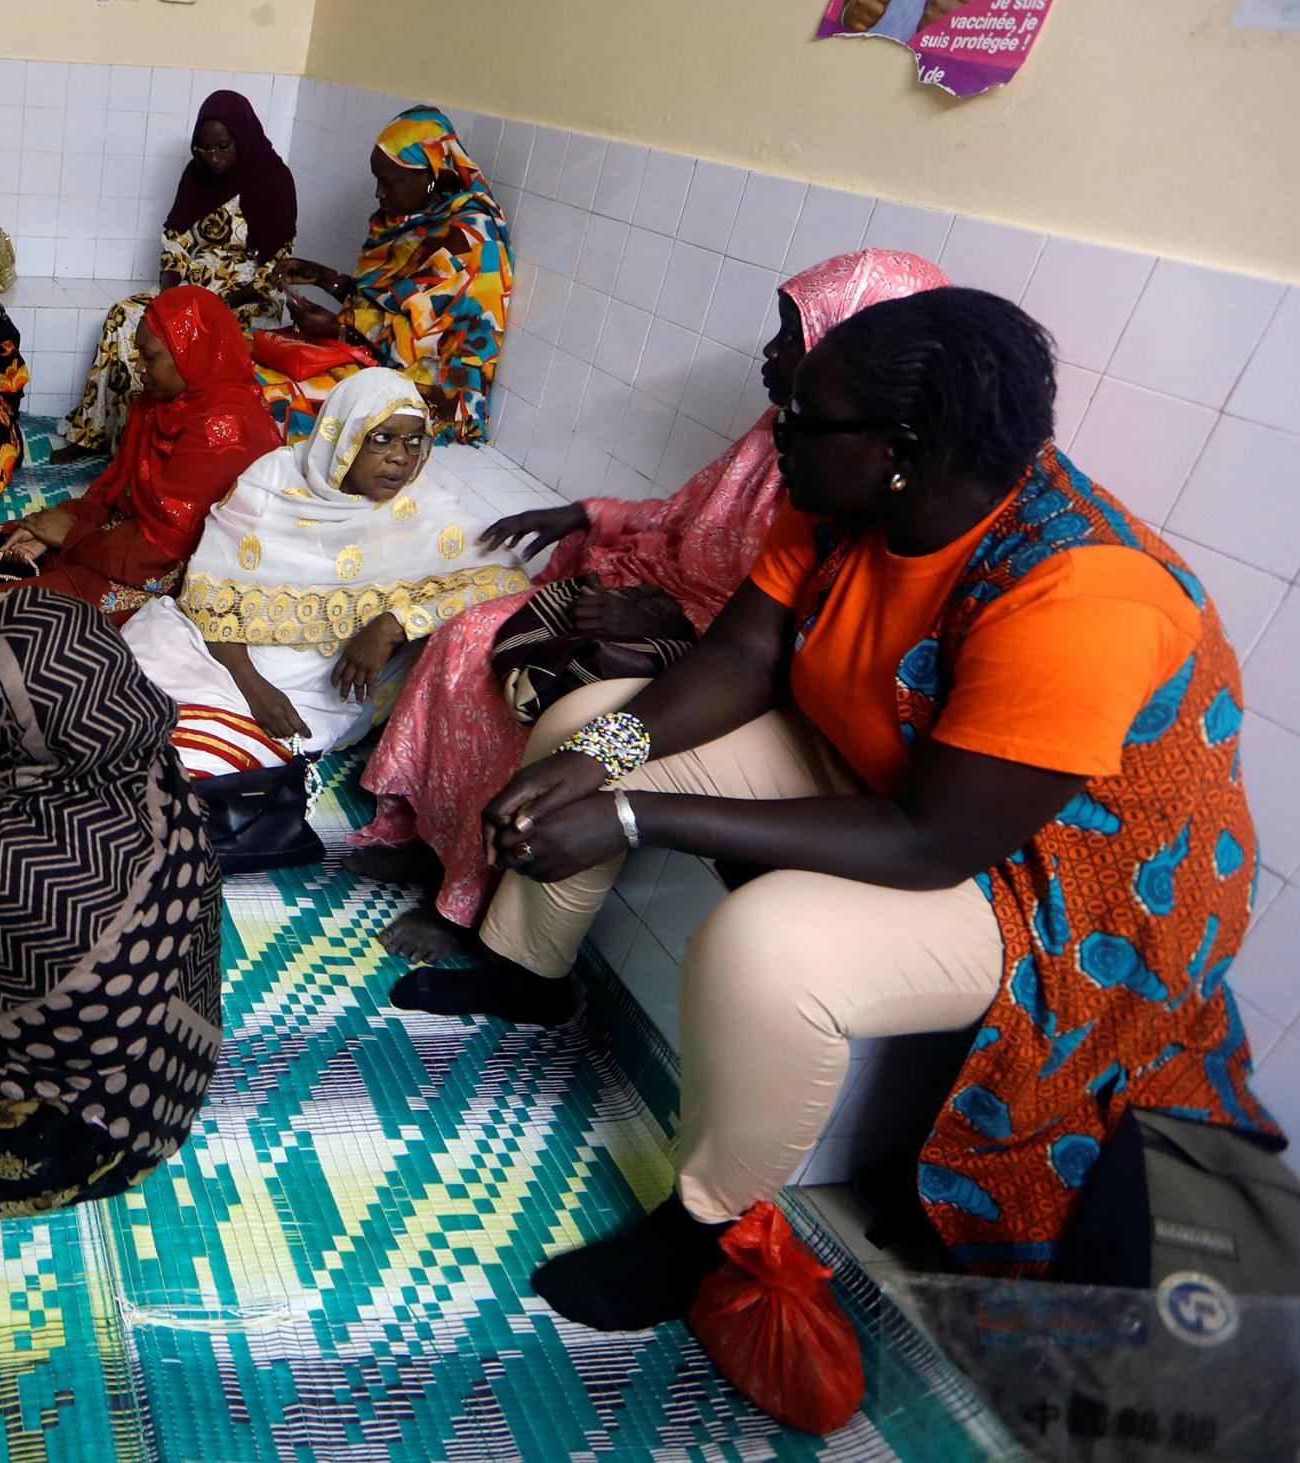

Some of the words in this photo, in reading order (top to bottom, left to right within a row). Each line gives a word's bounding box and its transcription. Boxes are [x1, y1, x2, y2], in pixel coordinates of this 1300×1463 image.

[1013, 0, 1046, 10] suis
[950, 12, 1017, 33] vaccinée,
[1017, 12, 1038, 34] je
[920, 32, 950, 48] suis
[949, 32, 1019, 54] protégée
[923, 66, 946, 83] de
